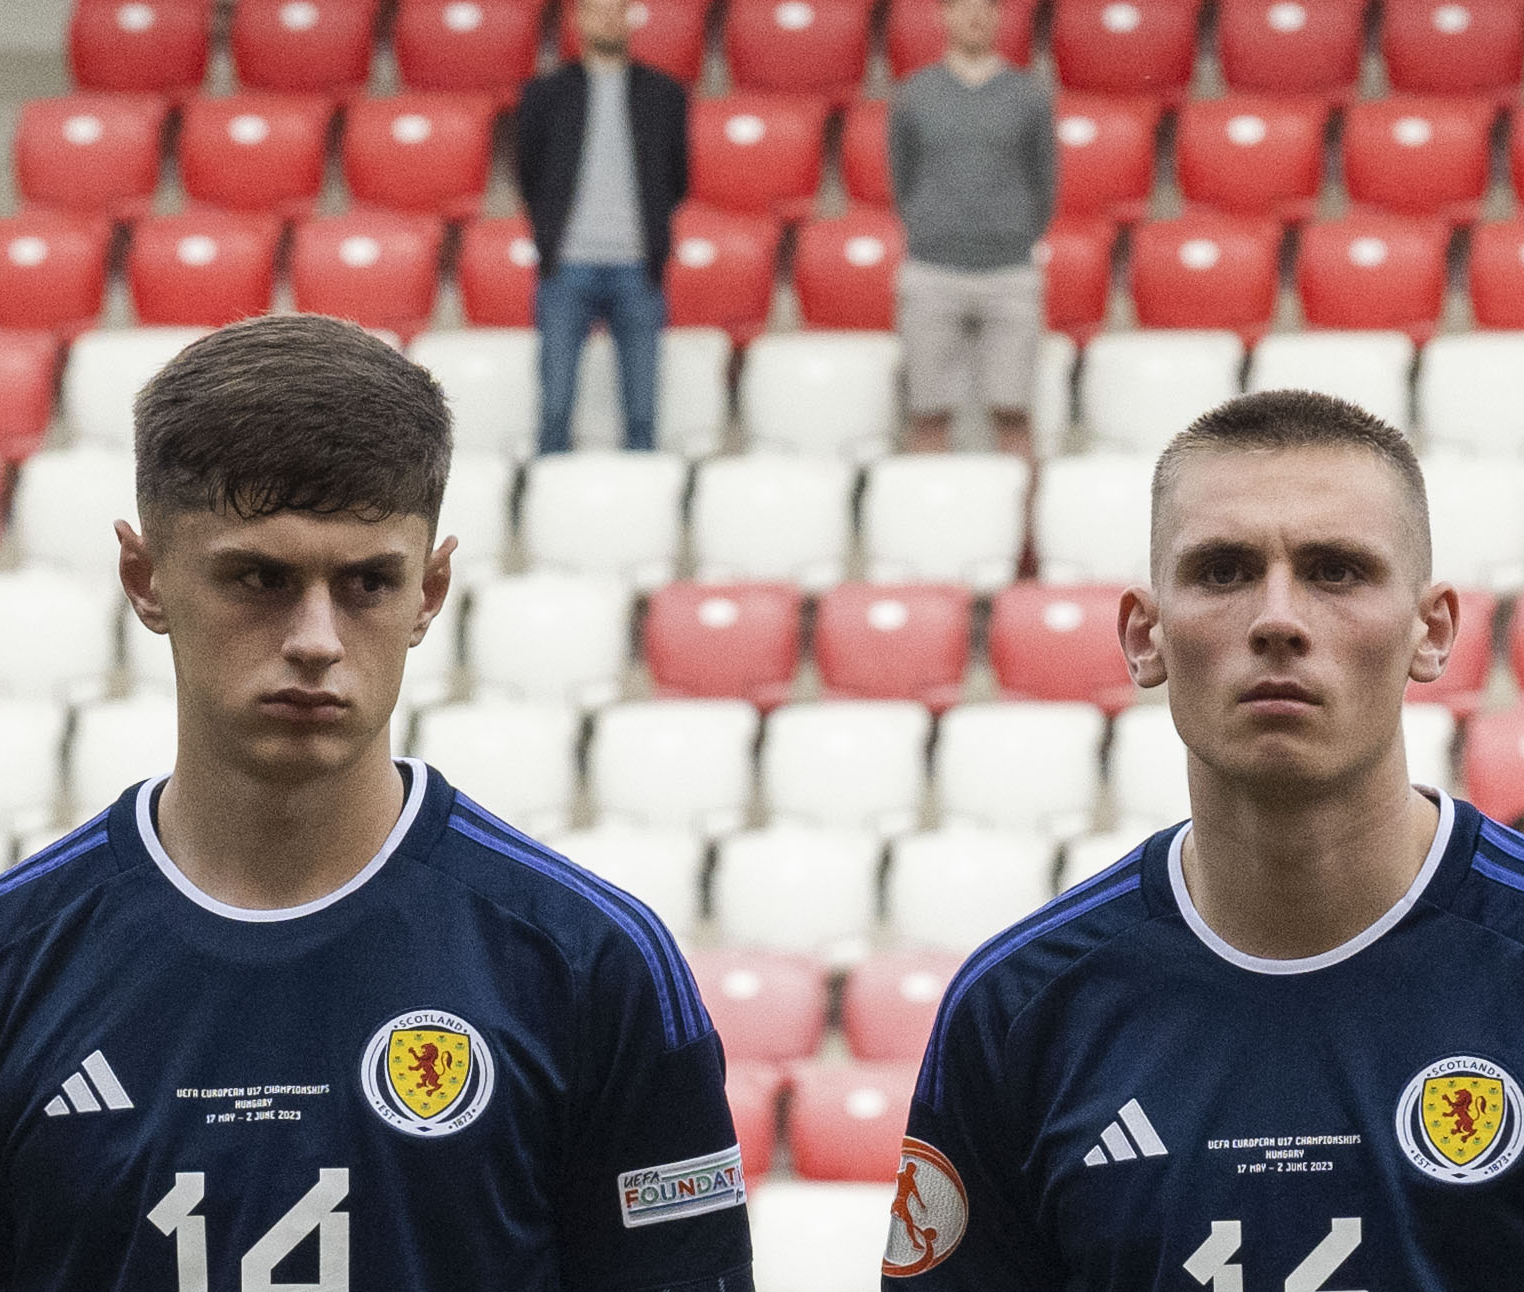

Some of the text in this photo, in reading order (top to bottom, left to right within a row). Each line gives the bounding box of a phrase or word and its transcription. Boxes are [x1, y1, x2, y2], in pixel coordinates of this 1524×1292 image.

[398, 1014, 463, 1031] SCOTLAND
[1432, 1060, 1496, 1076] SCOTLAND
[176, 1084, 330, 1098] UEFA EUROPEAN U17 CHAMPIONSHIPS
[234, 1098, 273, 1109] HUNGARY
[206, 1114, 216, 1124] 17
[218, 1113, 236, 1122] MAY
[246, 1112, 252, 1121] 2
[254, 1110, 276, 1121] JUNE
[278, 1110, 302, 1120] 2023
[378, 1104, 396, 1120] EST
[452, 1111, 473, 1129] 1873
[1208, 1135, 1362, 1150] UEFA EUROPEAN U17 CHAMPIONSHIPS
[1265, 1149, 1305, 1159] HUNGARY
[1413, 1153, 1431, 1169] EST
[1237, 1164, 1246, 1174] 17
[1249, 1163, 1267, 1173] MAY
[1277, 1162, 1283, 1172] 2
[1285, 1162, 1308, 1172] JUNE
[1310, 1161, 1334, 1171] 2023
[1488, 1155, 1509, 1173] 1873
[624, 1170, 661, 1188] UEFA
